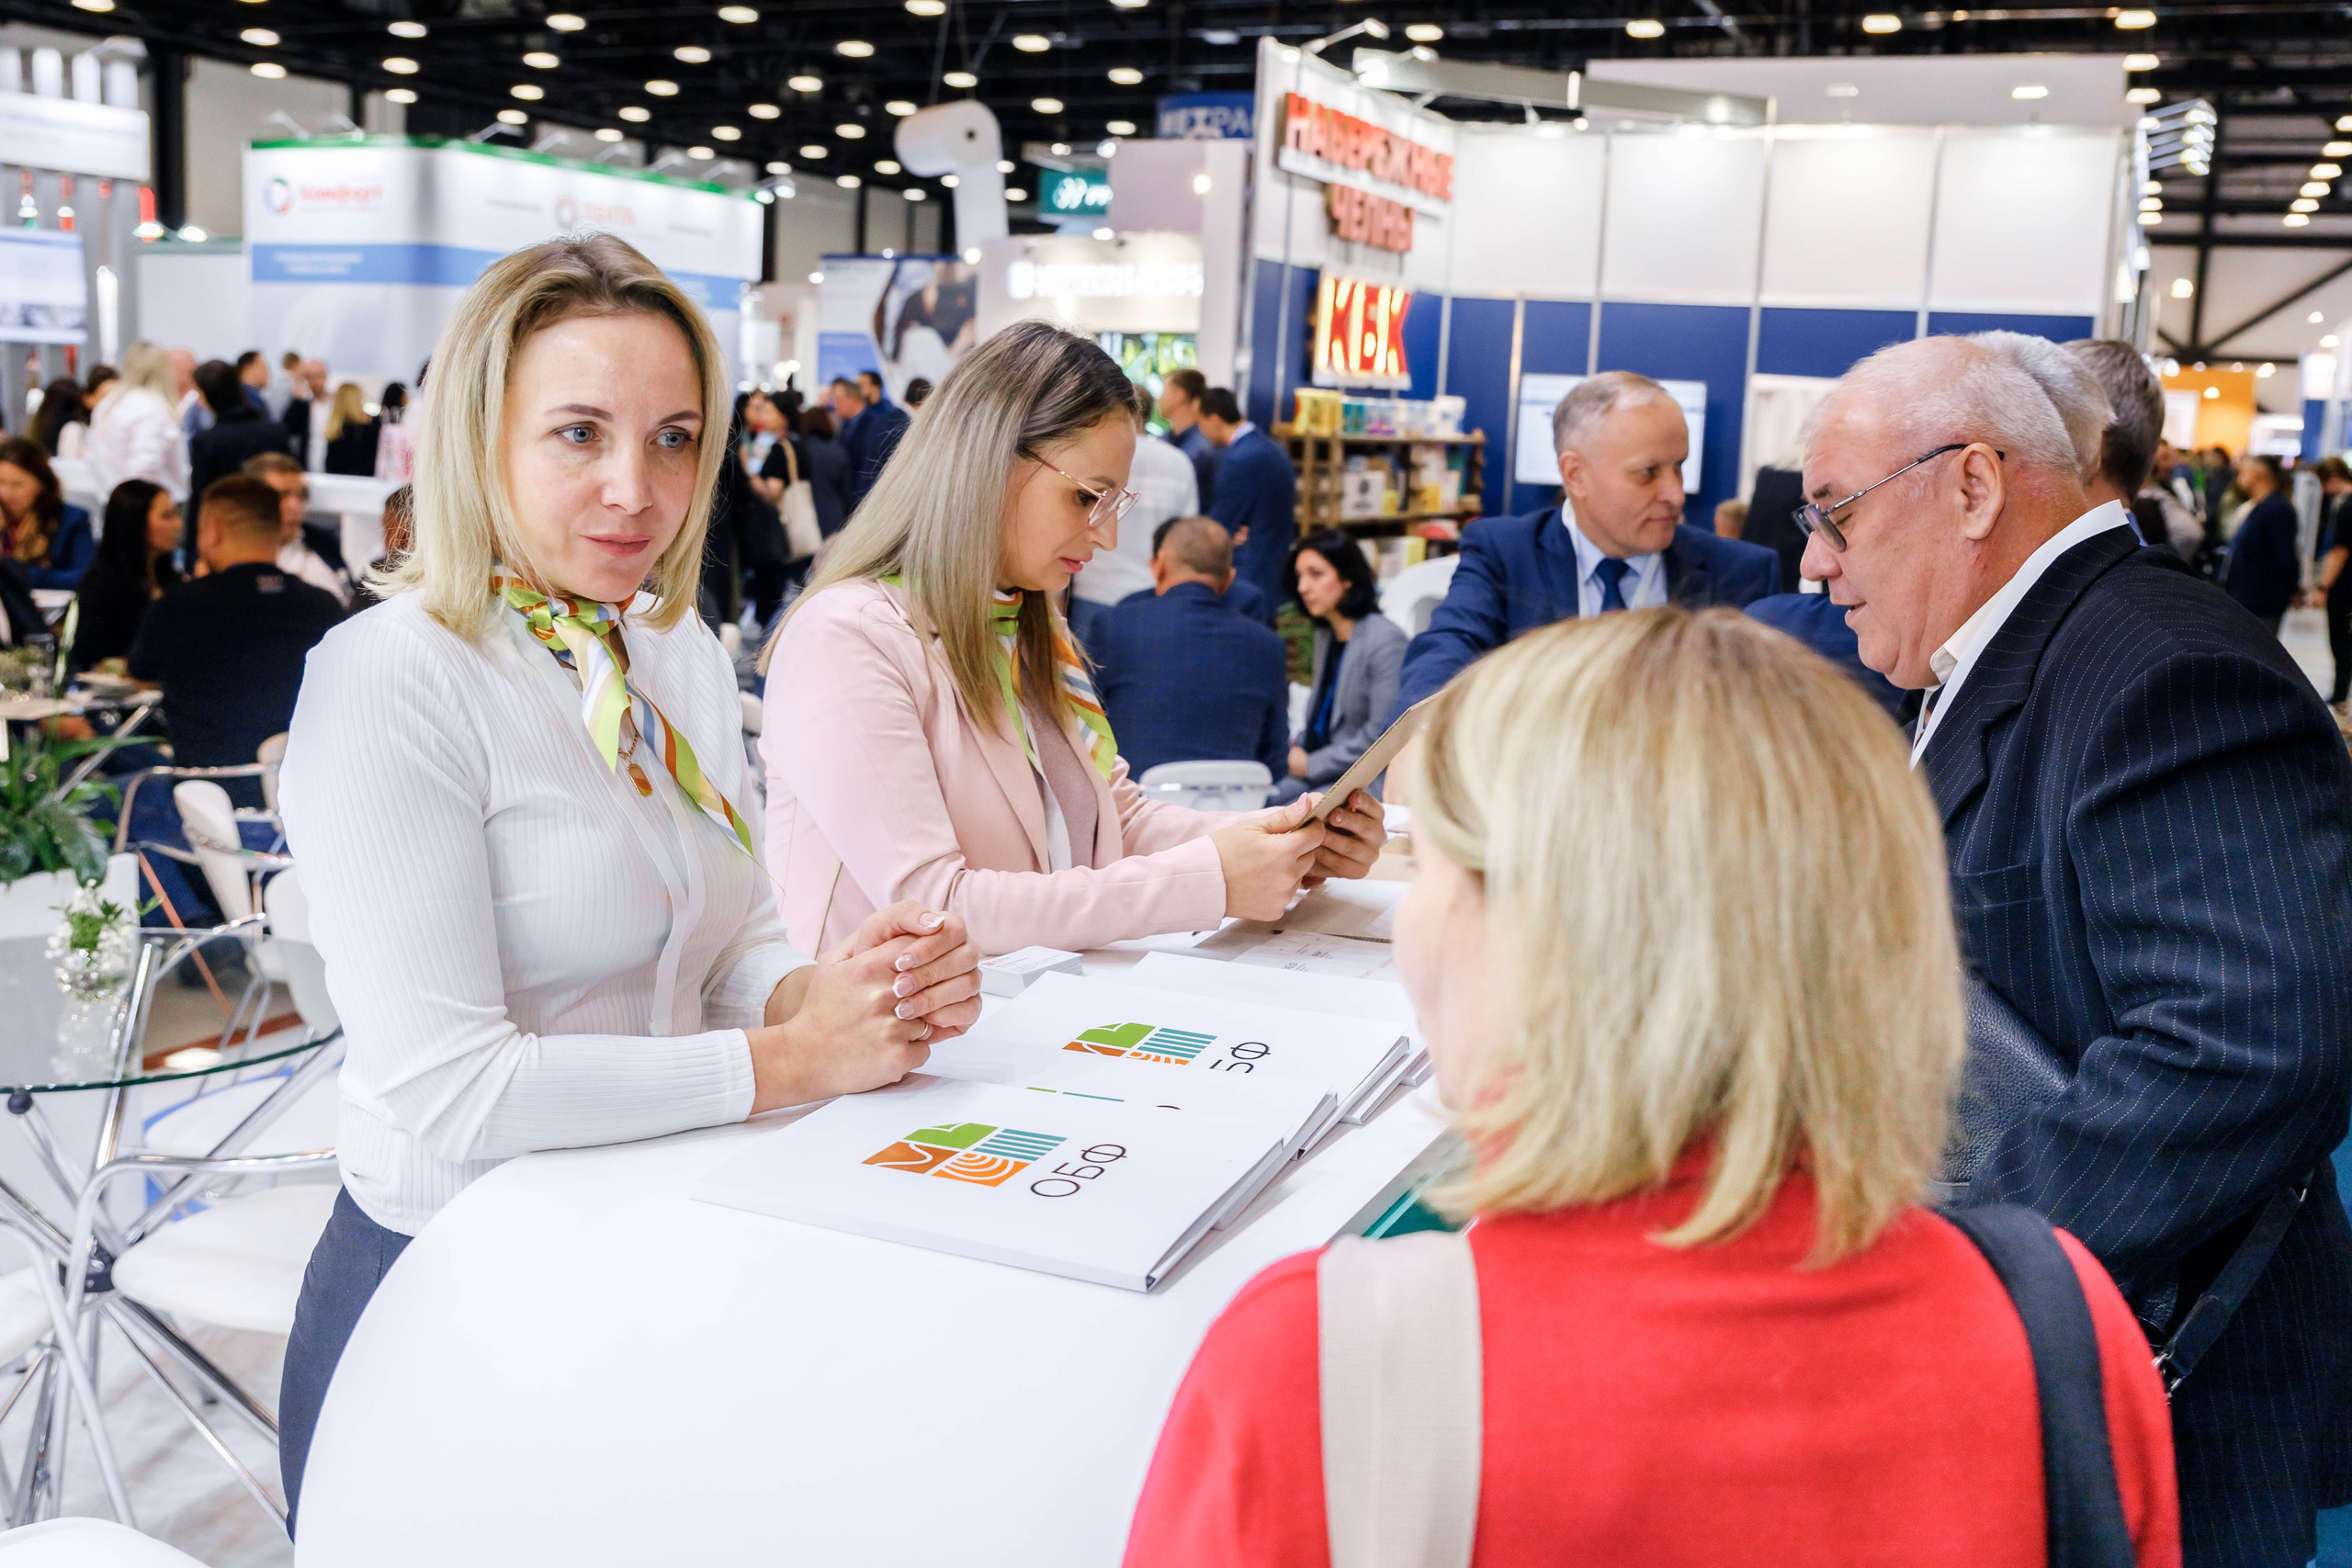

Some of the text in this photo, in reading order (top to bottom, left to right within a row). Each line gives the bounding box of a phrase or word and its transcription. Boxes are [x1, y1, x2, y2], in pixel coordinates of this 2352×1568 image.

[1284, 92, 1453, 202] НАБЕРЕЖНЫЕ
[1329, 183, 1416, 254] ЧЕЛНЫ
[1209, 1042, 1272, 1074] БФ
[1030, 1144, 1127, 1197] ОБФ
